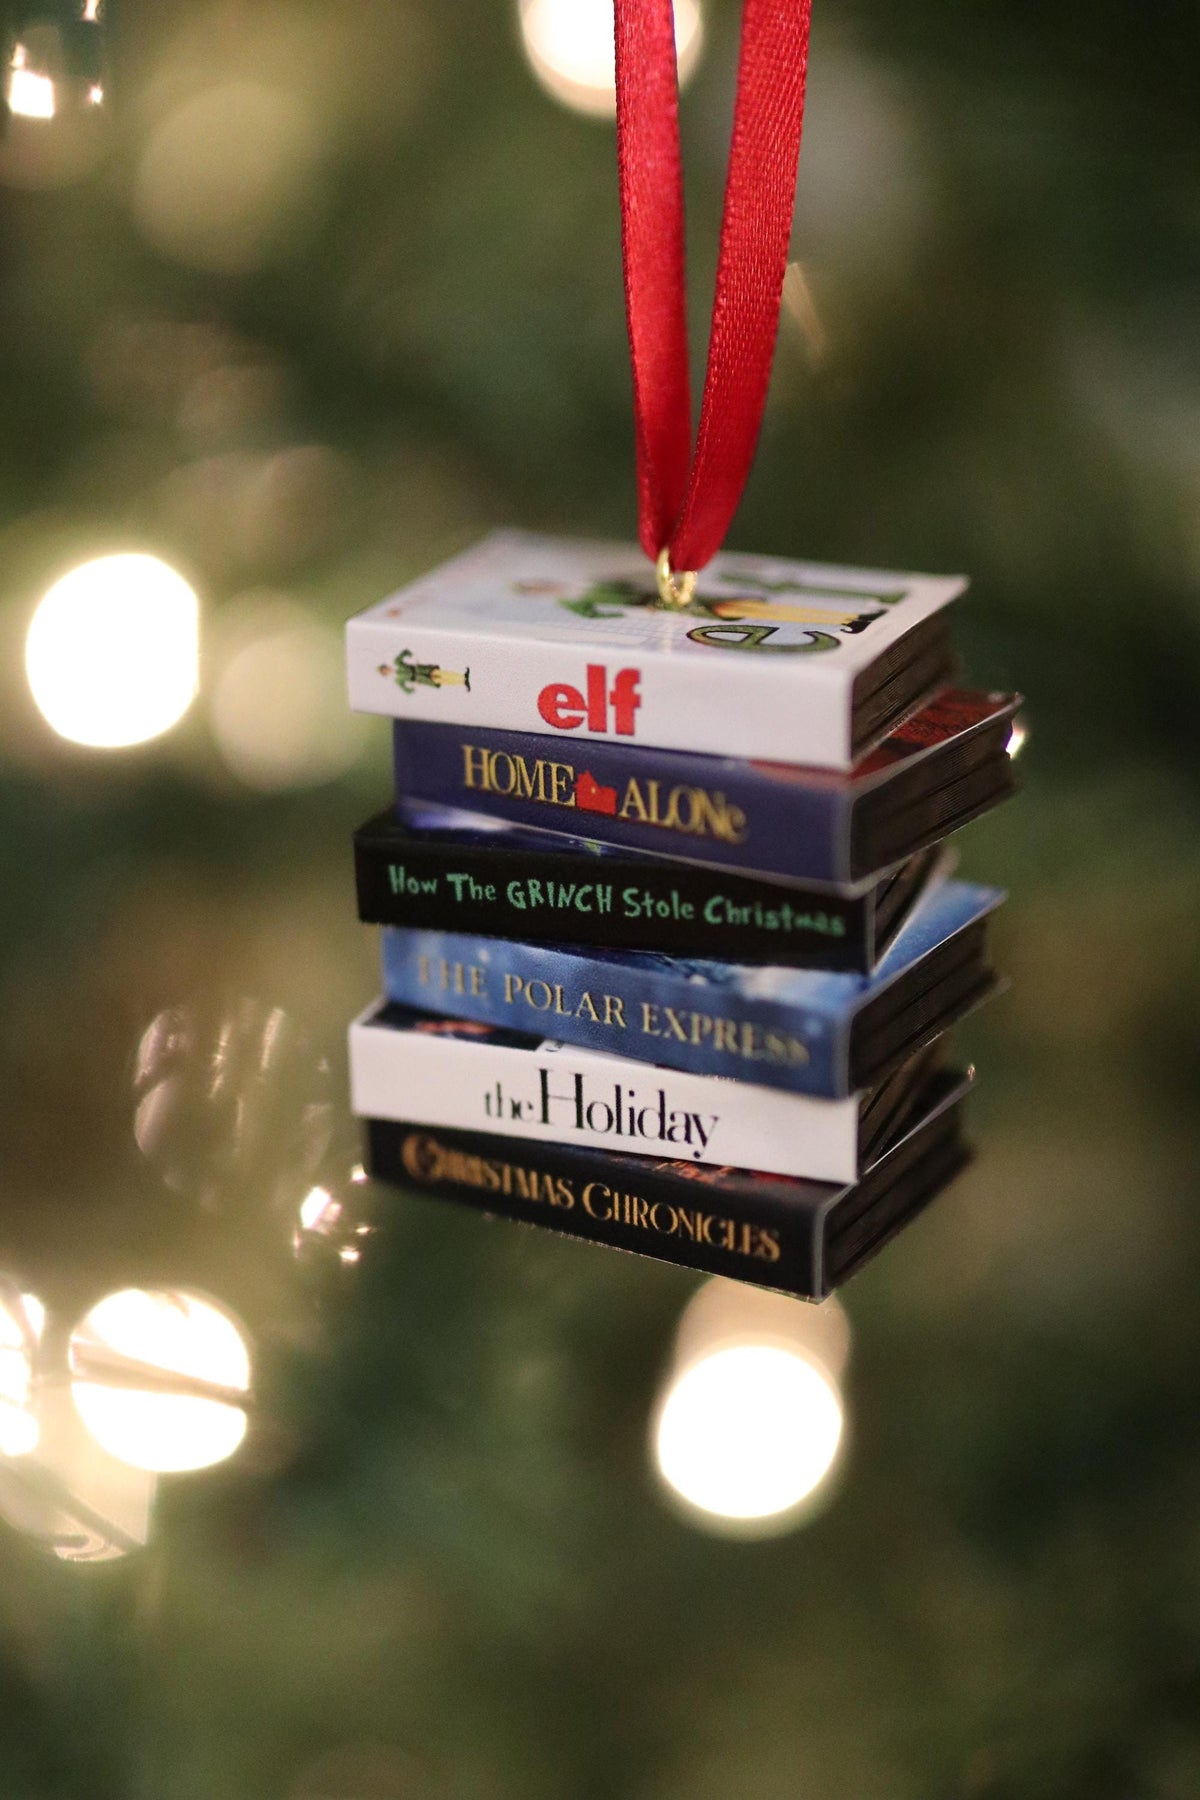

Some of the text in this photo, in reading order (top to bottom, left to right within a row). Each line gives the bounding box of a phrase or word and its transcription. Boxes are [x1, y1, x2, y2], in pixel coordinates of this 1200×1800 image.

[537, 663, 642, 735] elf
[462, 744, 576, 808] HOME
[388, 864, 846, 938] How The GRINCH Stole Christmas
[416, 955, 811, 1069] THE POLAR EXPRESS
[538, 1067, 720, 1159] Holiday
[583, 1183, 782, 1263] CHRONICLES
